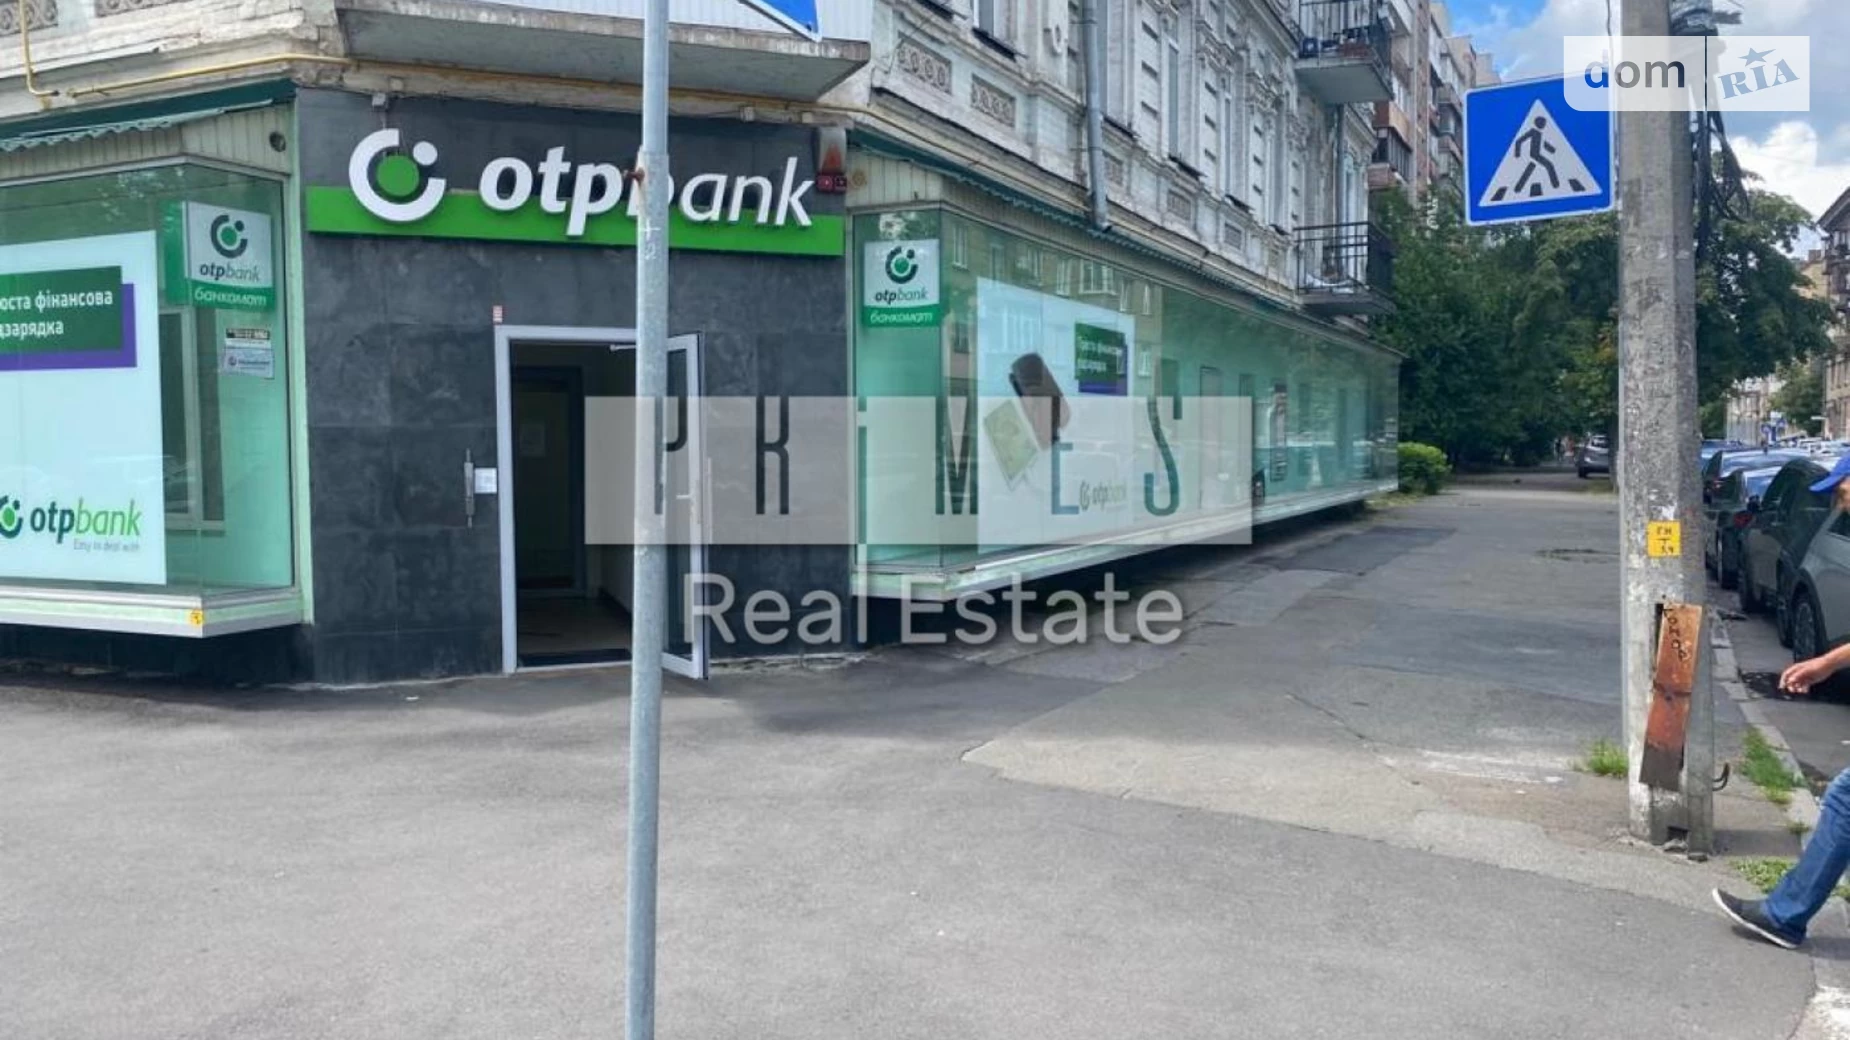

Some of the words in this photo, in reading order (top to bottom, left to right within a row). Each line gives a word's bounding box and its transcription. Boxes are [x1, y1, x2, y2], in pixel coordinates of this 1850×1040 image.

[200, 262, 260, 281] otpbank
[34, 289, 113, 314] фінансова
[875, 286, 928, 305] otpbank
[30, 497, 142, 544] otpbank
